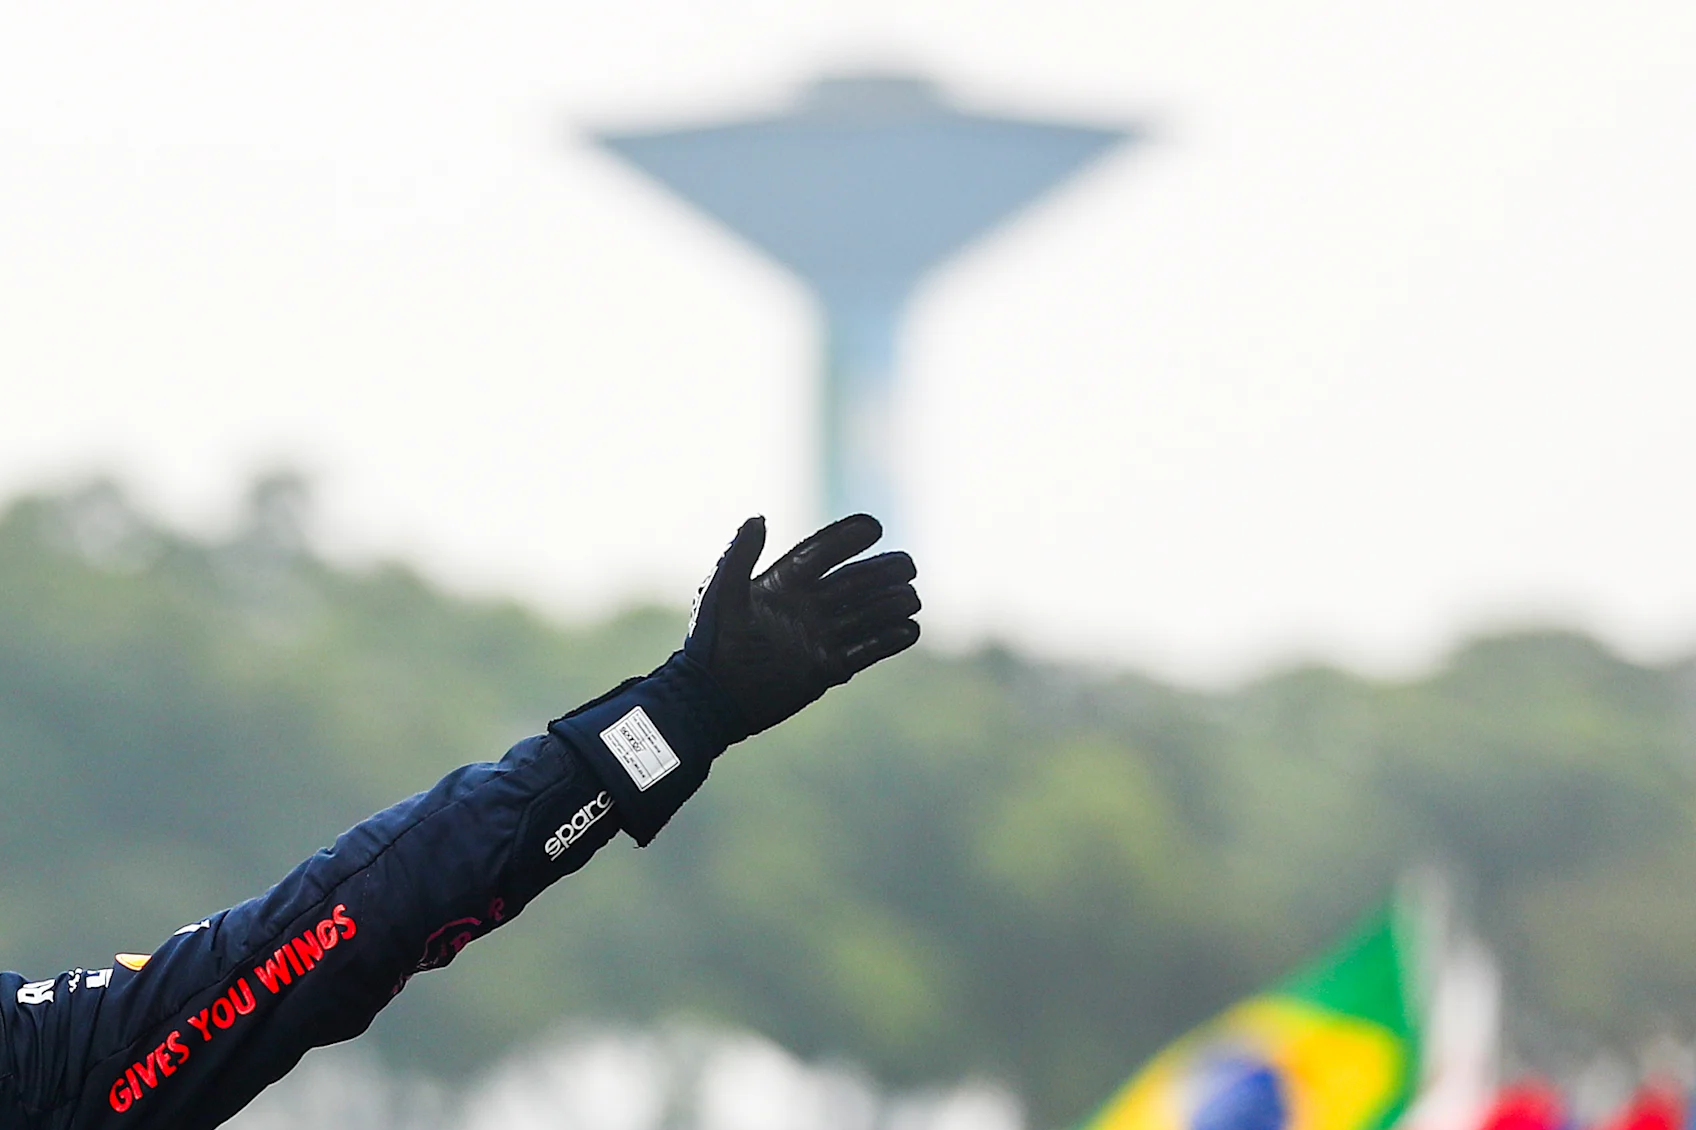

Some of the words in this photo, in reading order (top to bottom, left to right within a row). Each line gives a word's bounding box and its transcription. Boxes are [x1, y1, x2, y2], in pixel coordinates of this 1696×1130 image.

[545, 790, 613, 857] sparc
[109, 1030, 190, 1114] GIVES
[188, 980, 257, 1042] YOU
[256, 903, 358, 994] WINGS
